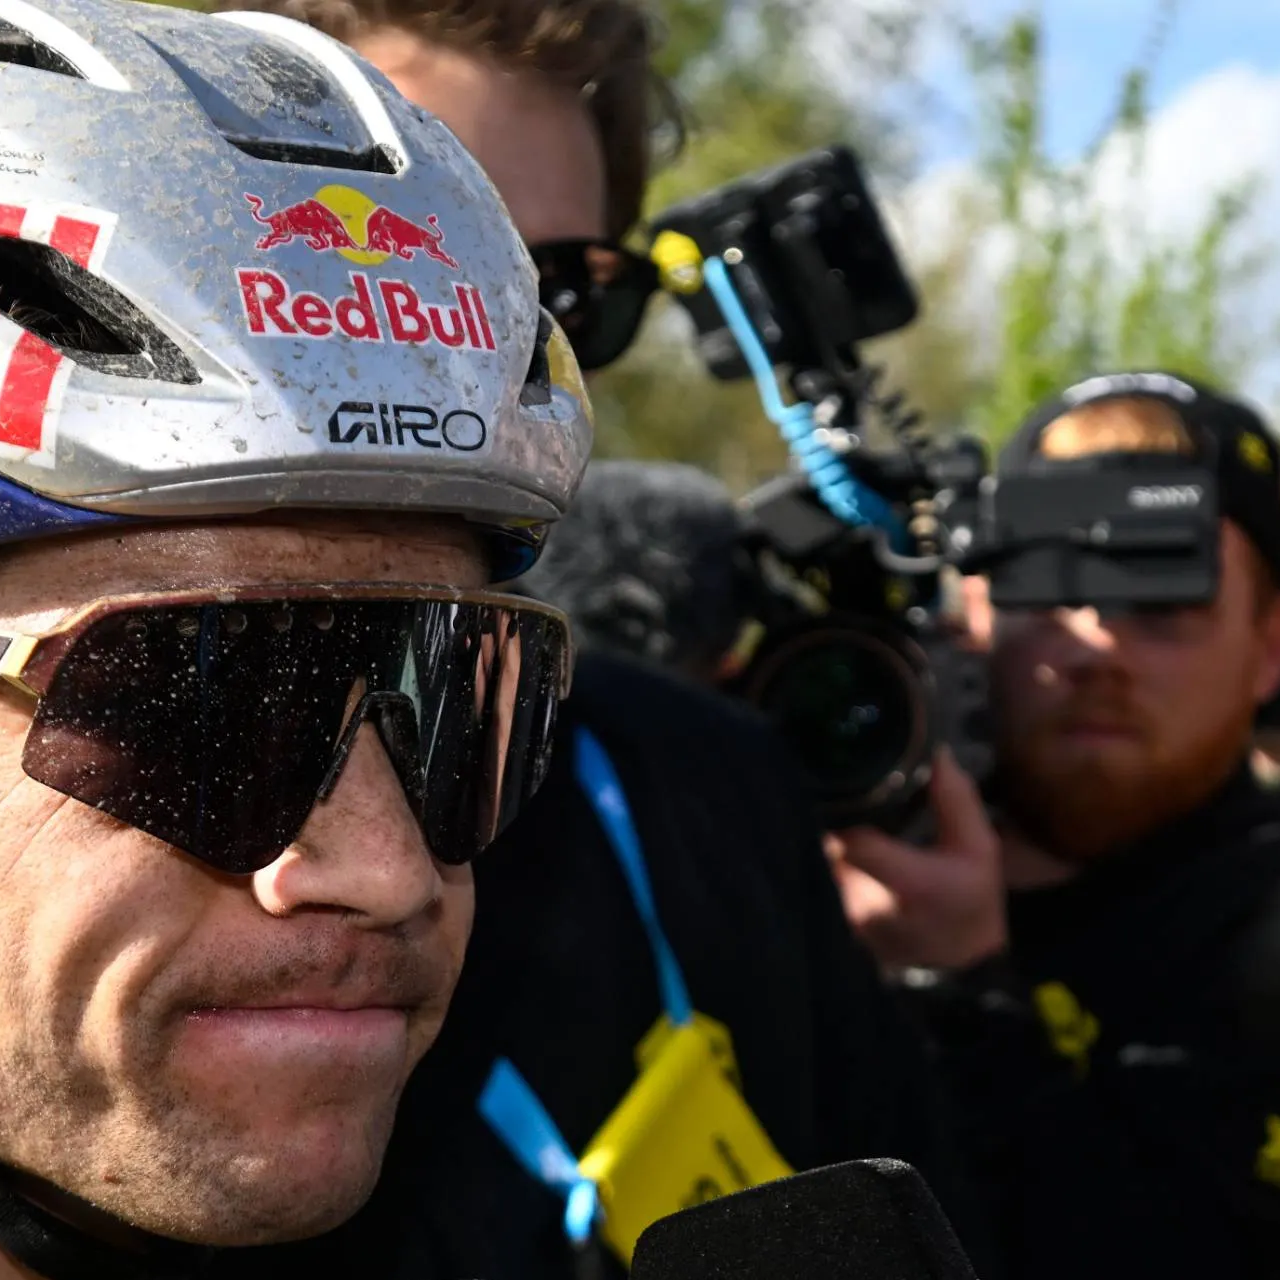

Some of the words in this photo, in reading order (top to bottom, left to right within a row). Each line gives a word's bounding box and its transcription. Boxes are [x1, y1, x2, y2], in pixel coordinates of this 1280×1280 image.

[237, 269, 383, 341] Red
[377, 279, 498, 351] Bull
[327, 401, 487, 452] GIRO
